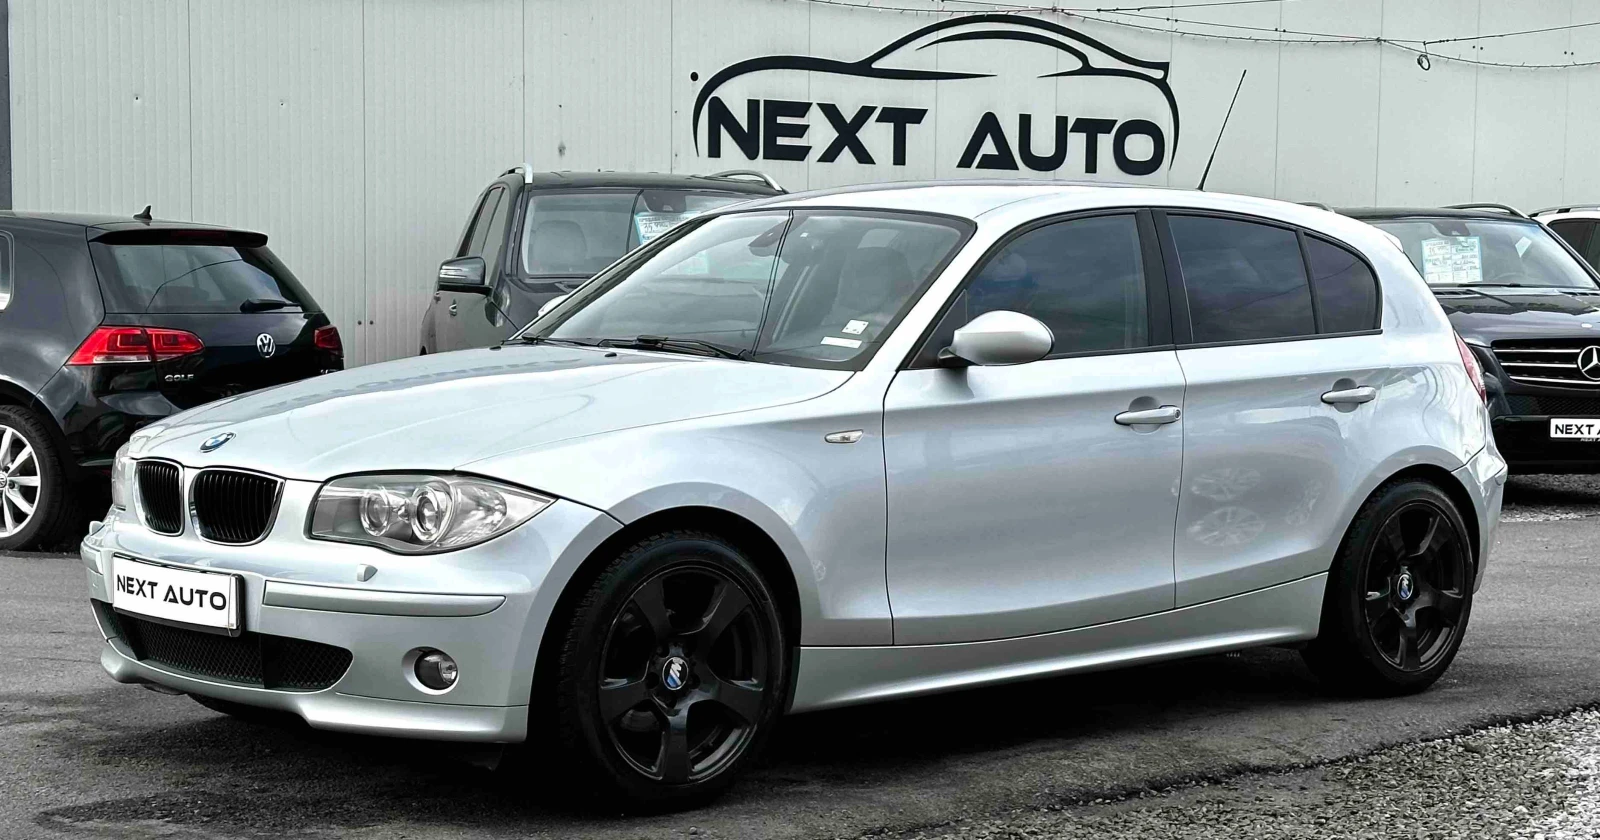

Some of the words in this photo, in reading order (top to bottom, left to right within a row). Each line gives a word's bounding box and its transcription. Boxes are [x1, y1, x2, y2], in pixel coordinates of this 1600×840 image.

[708, 96, 929, 166] NEXT
[956, 111, 1166, 176] AUTO
[164, 374, 195, 382] GOLF
[1555, 424, 1595, 435] NEXT
[116, 574, 158, 599] NEXT
[163, 584, 227, 610] AUTO
